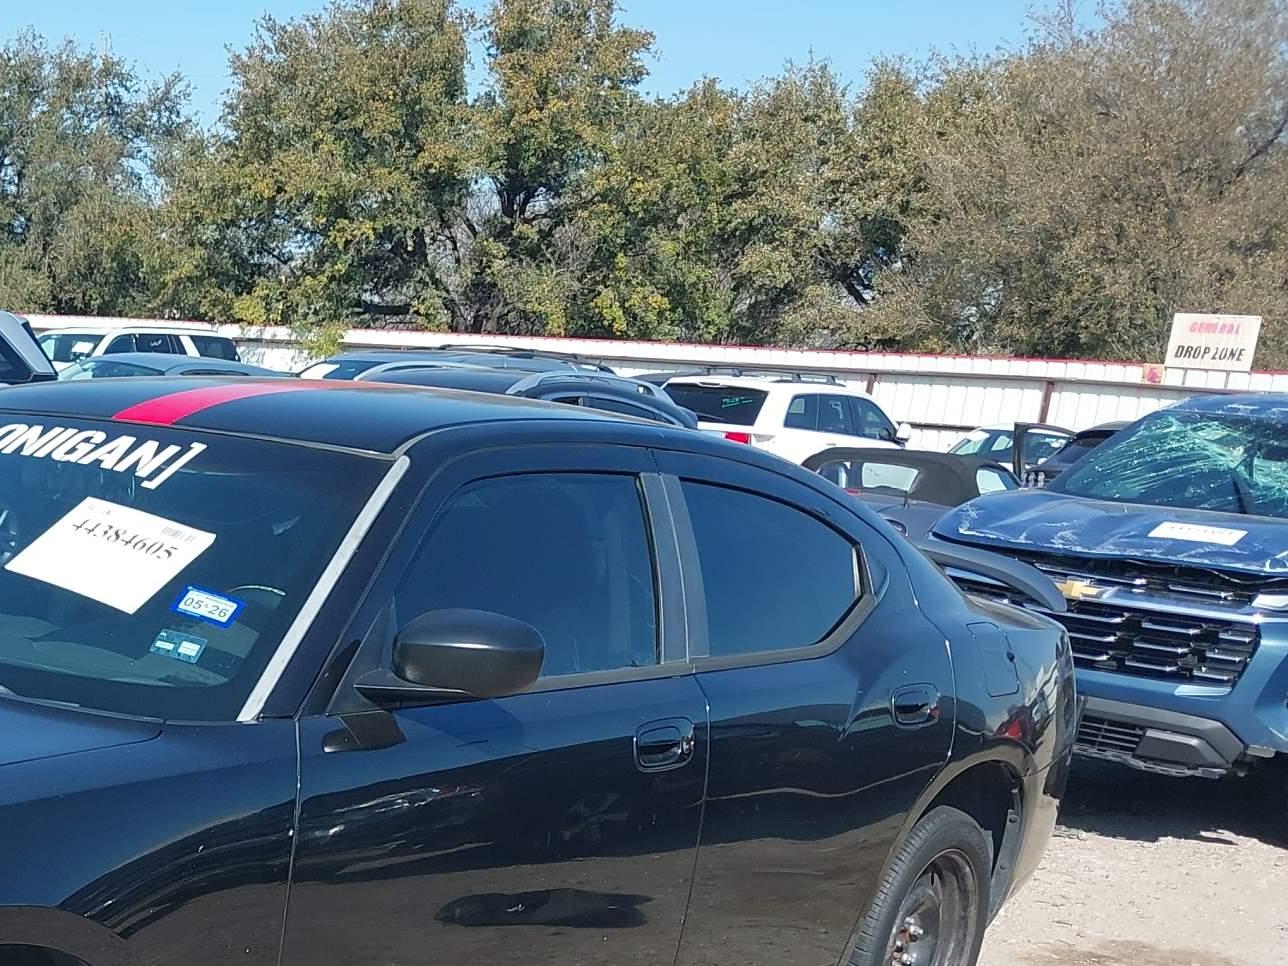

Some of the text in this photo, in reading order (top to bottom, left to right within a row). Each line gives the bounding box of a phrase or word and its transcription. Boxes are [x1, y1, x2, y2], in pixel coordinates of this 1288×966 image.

[1174, 344, 1246, 362] DROP ZONE
[72, 519, 179, 559] 44384605
